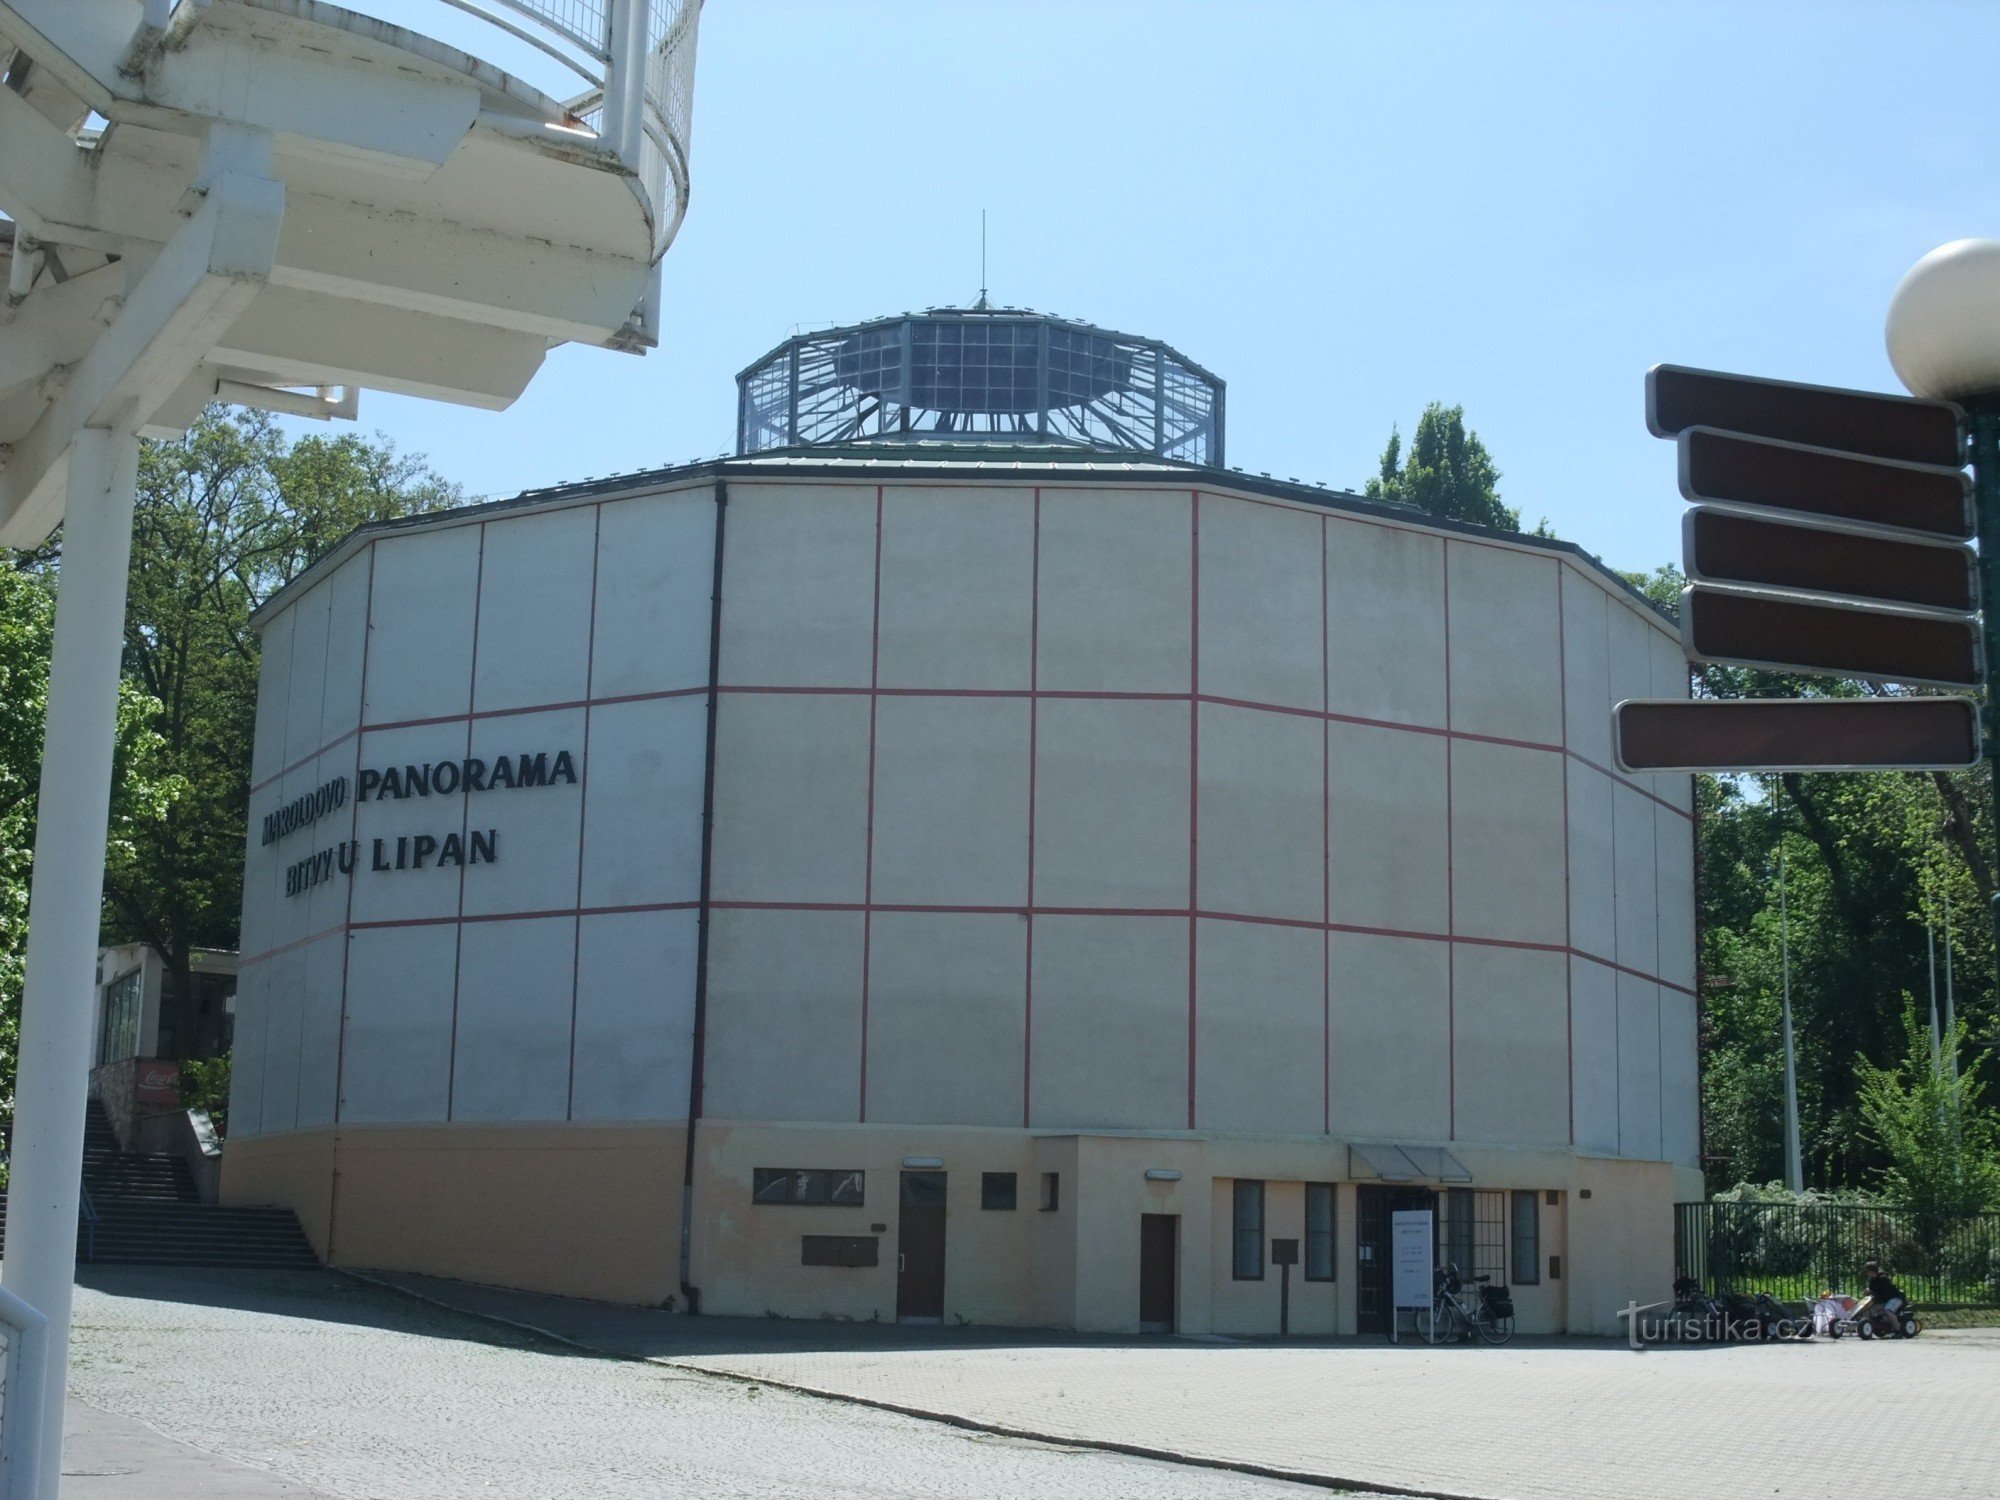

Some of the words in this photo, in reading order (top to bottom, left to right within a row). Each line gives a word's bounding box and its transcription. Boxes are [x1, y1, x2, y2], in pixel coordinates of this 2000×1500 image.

[262, 776, 345, 847] MAROLDOVO
[358, 750, 577, 802] PANORAMA
[285, 847, 333, 898] BITVY
[338, 840, 358, 874] U
[372, 829, 497, 872] LIPAN
